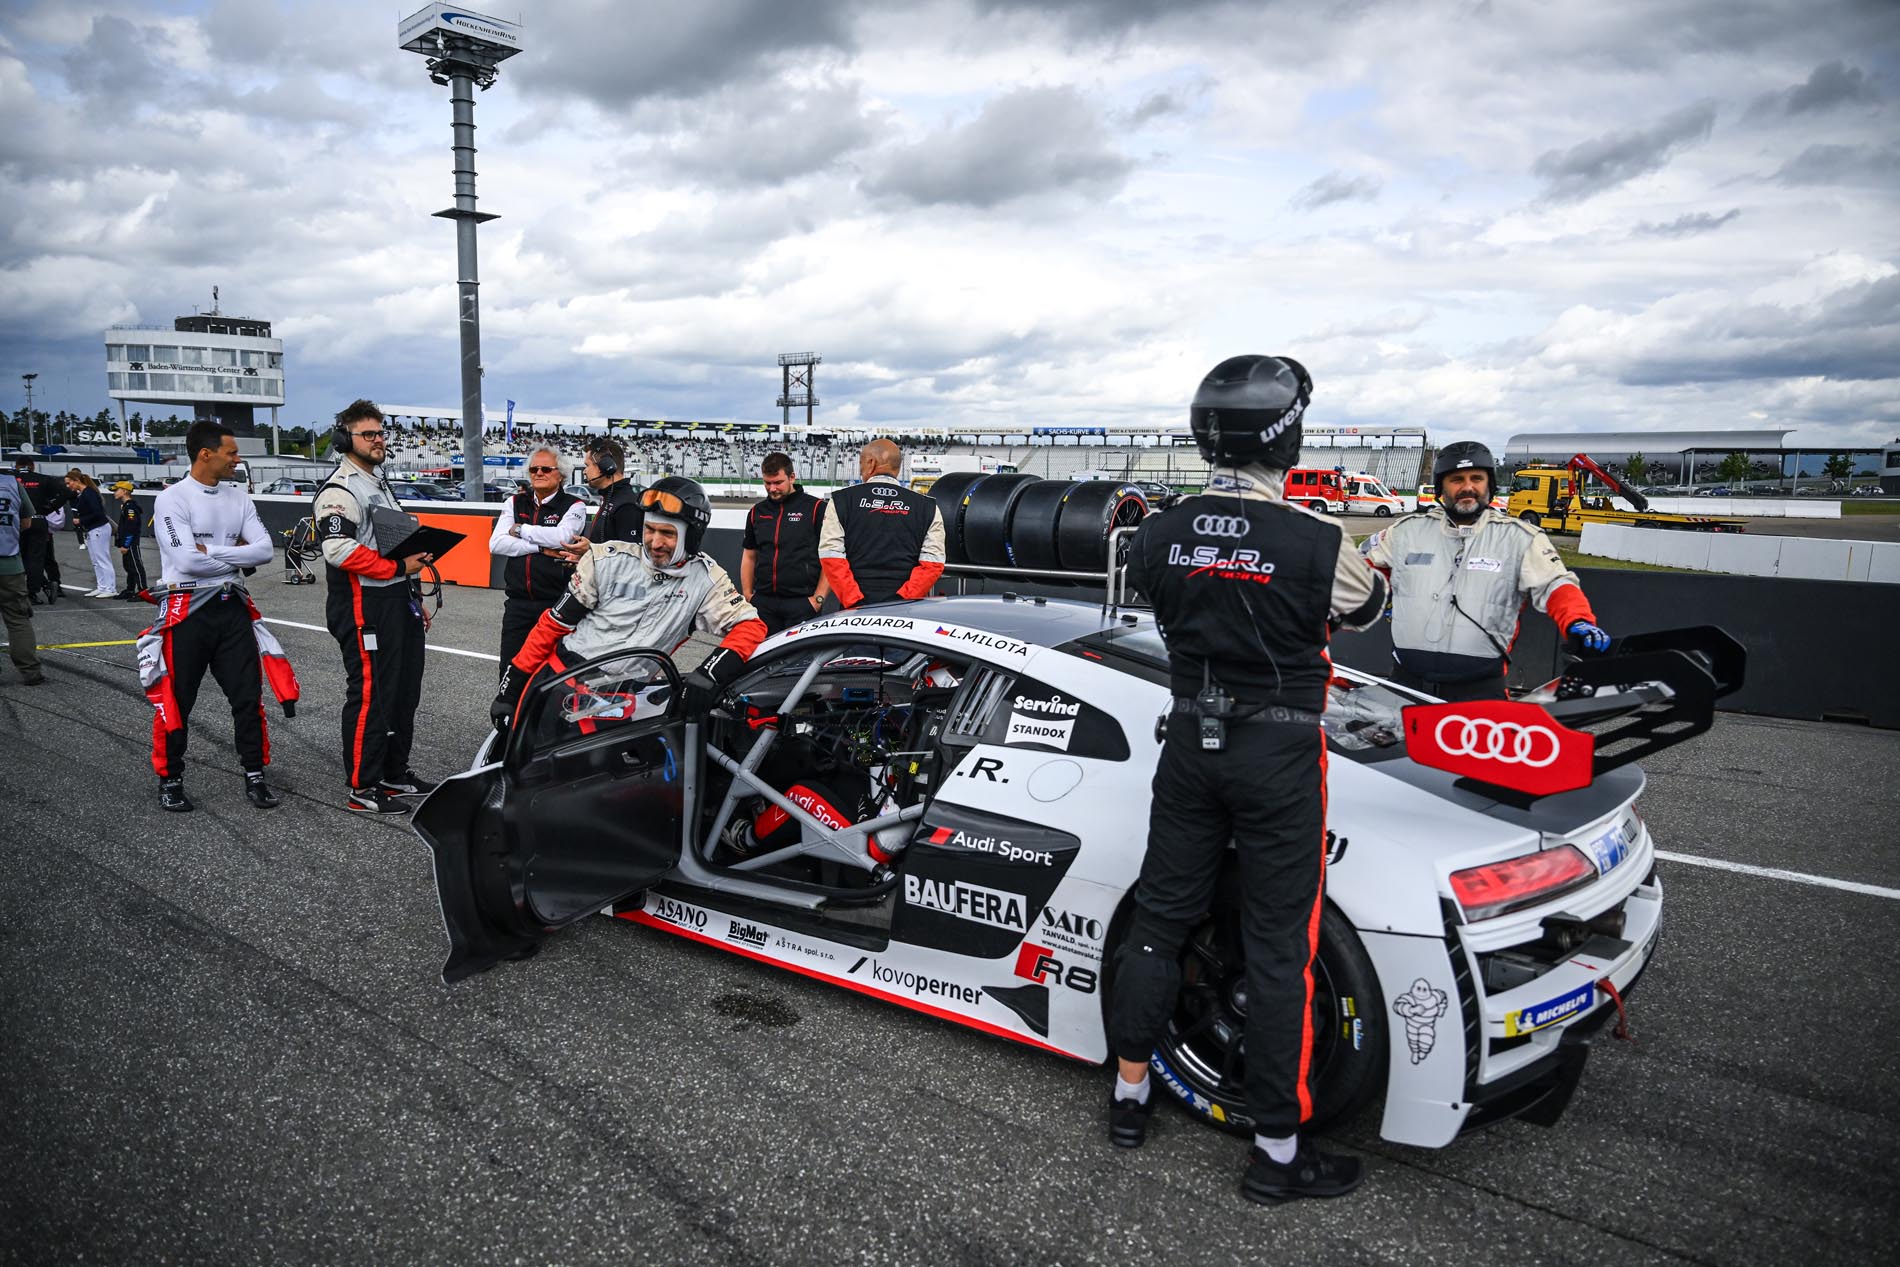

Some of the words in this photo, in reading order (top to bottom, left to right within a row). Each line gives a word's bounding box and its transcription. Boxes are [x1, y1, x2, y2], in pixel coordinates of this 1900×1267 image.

[148, 363, 217, 374] Baden-Württemberg
[217, 366, 241, 374] Center
[1259, 398, 1304, 444] uvex
[78, 430, 152, 442] SACHS
[859, 498, 910, 511] I.S.R.
[328, 515, 342, 533] 3
[1168, 543, 1275, 575] I.S.R.
[1208, 569, 1272, 585] racing
[798, 617, 915, 634] F.SALAQUARDA
[948, 628, 1028, 657] L.MILOTA
[1013, 695, 1081, 717] Servind
[1012, 724, 1066, 739] STANDOX
[952, 831, 996, 853] Audi
[997, 840, 1054, 867] Sport
[655, 898, 708, 928] ASANO
[904, 873, 1026, 932] BAUFERA
[1042, 905, 1104, 942] SATO
[872, 959, 983, 1006] kovoperner
[1033, 955, 1098, 995] R8
[1536, 992, 1588, 1025] MICHELIN
